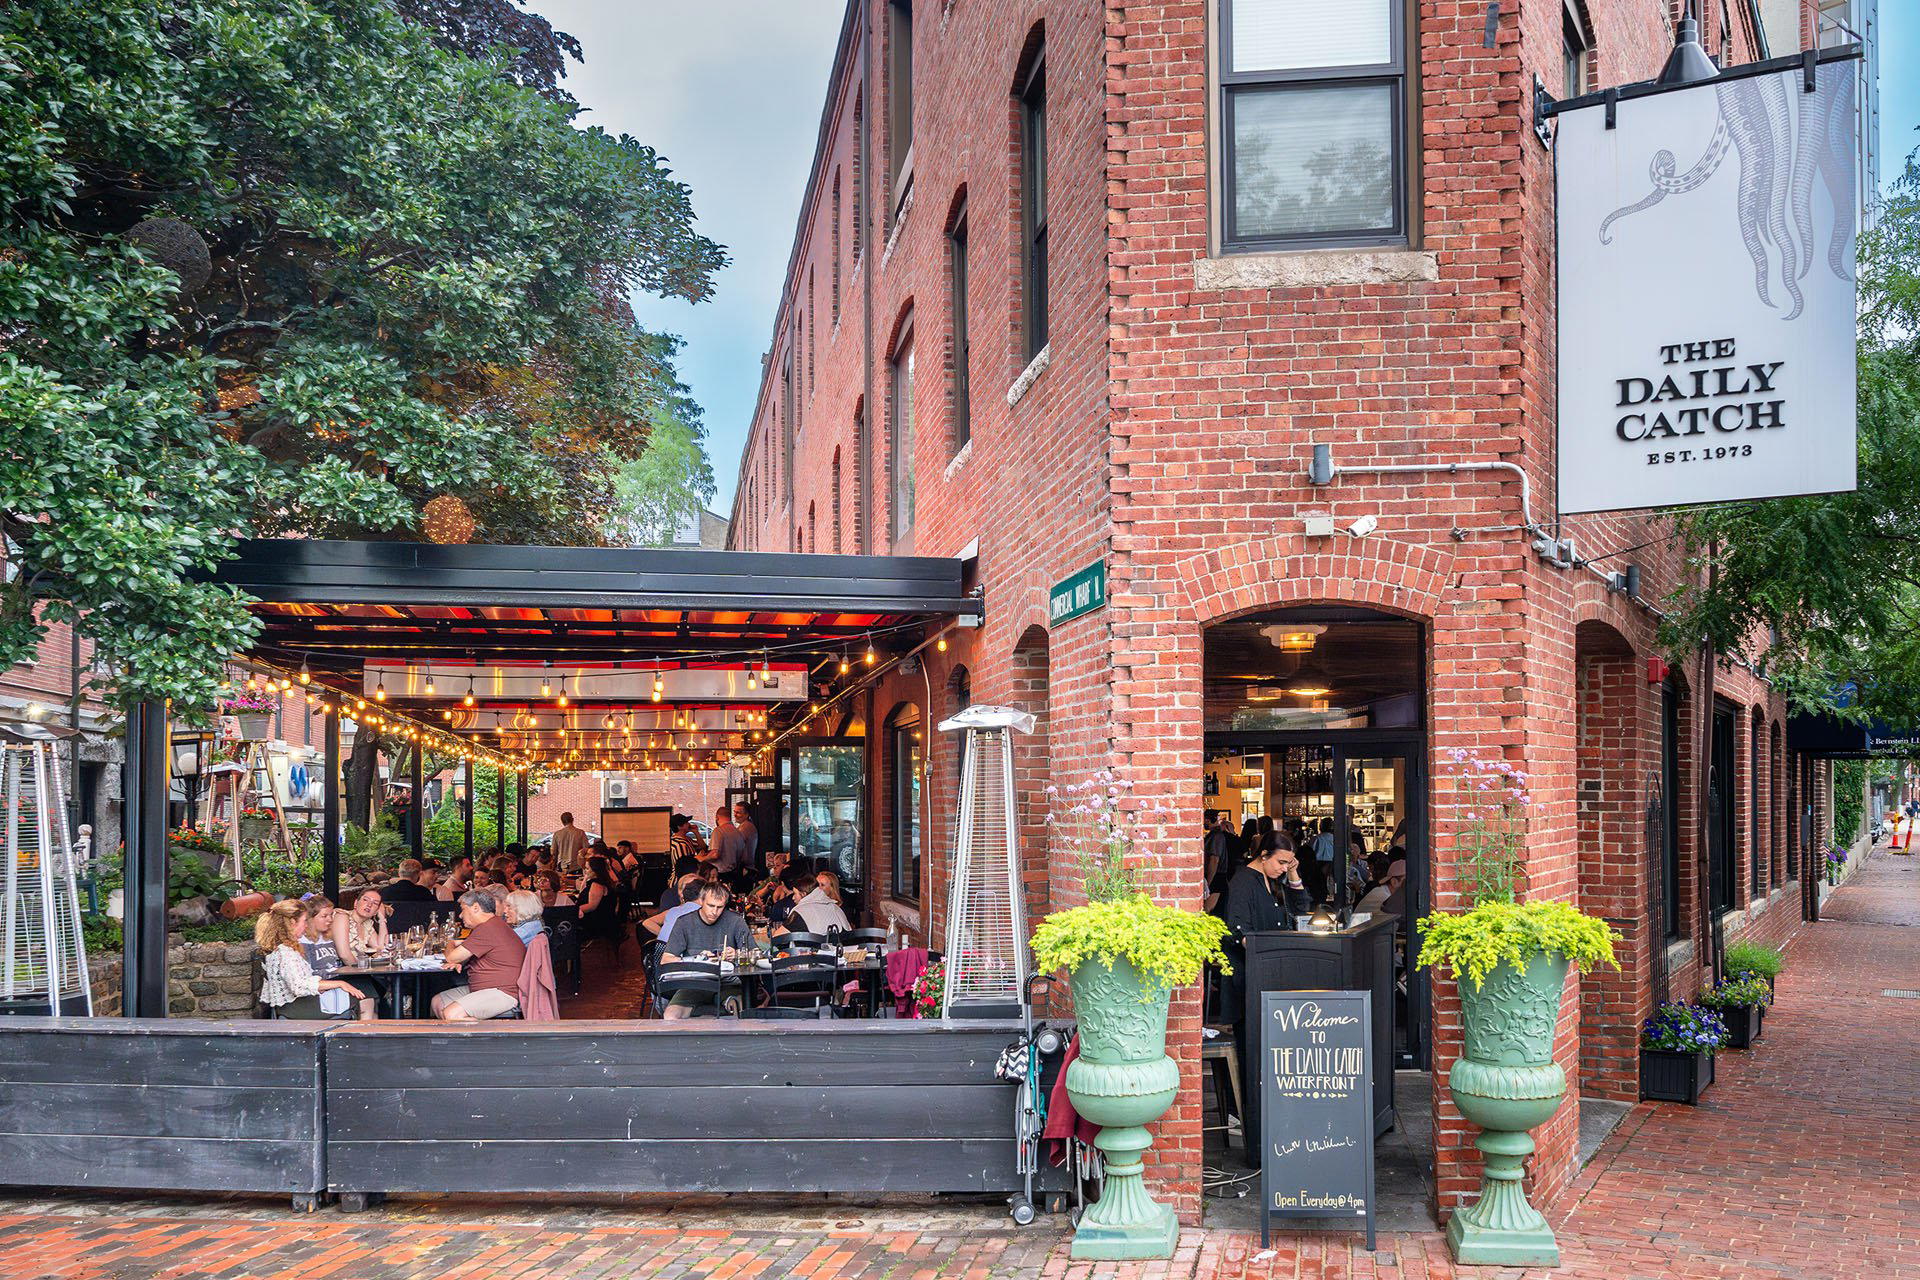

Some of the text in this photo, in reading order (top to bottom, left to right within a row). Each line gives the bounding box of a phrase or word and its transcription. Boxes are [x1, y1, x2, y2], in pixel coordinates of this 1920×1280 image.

[1660, 338, 1735, 365] THE
[1616, 361, 1784, 407] DAILY
[1616, 400, 1785, 442] CATCH
[1647, 445, 1752, 465] EST. 1973
[1273, 1001, 1359, 1032] Welcome
[1309, 1031, 1326, 1044] TO
[1270, 1047, 1363, 1075] THE DAILY CATCH
[1276, 1075, 1357, 1090] WATERFRONT
[1274, 1191, 1297, 1209] Open
